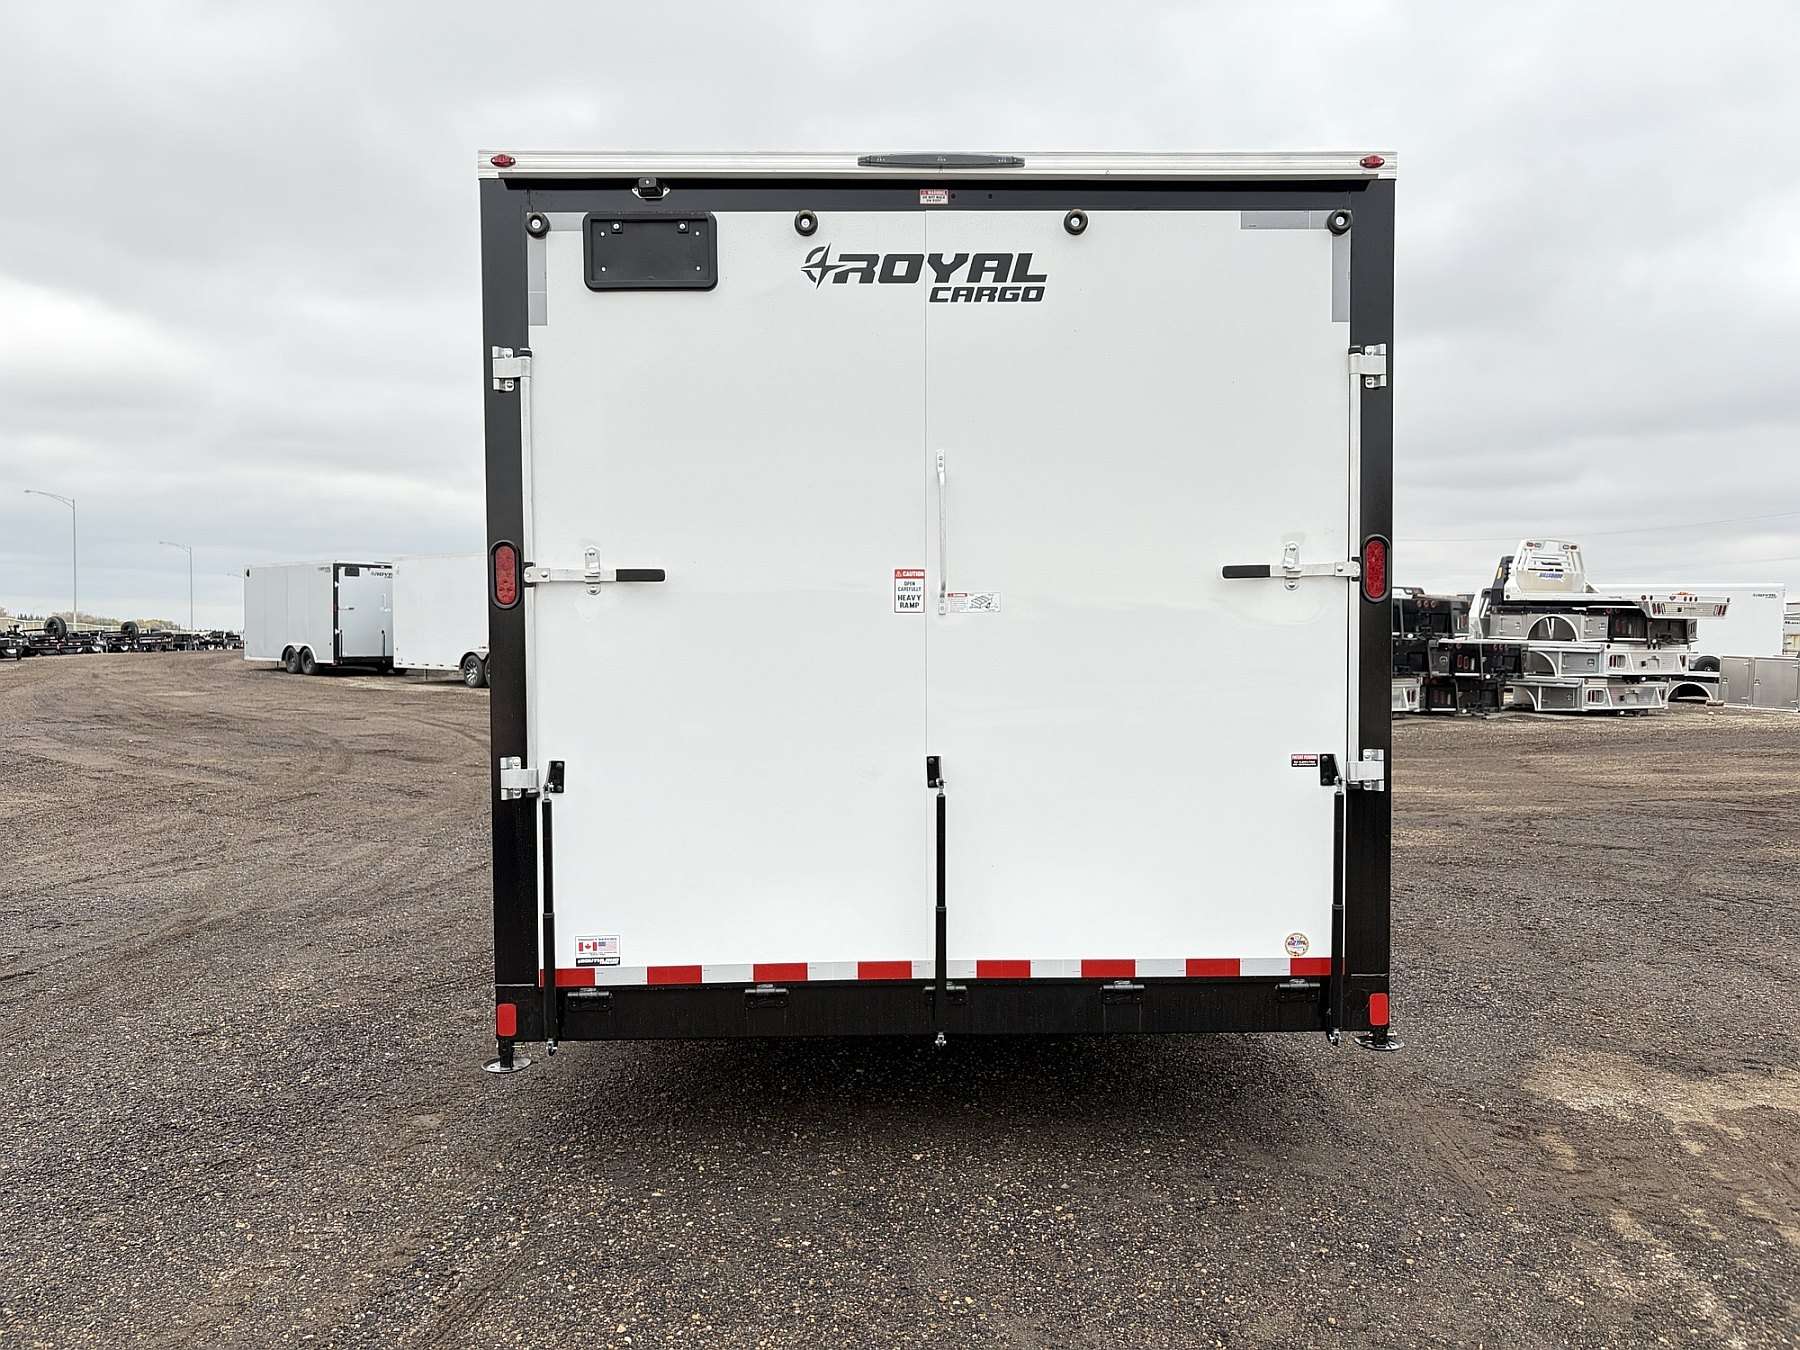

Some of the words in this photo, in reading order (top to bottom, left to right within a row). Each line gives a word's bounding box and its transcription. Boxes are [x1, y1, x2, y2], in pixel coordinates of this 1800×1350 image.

[832, 252, 1048, 284] ROYAL
[929, 286, 1046, 303] CARGO
[899, 601, 920, 609] RAMP
